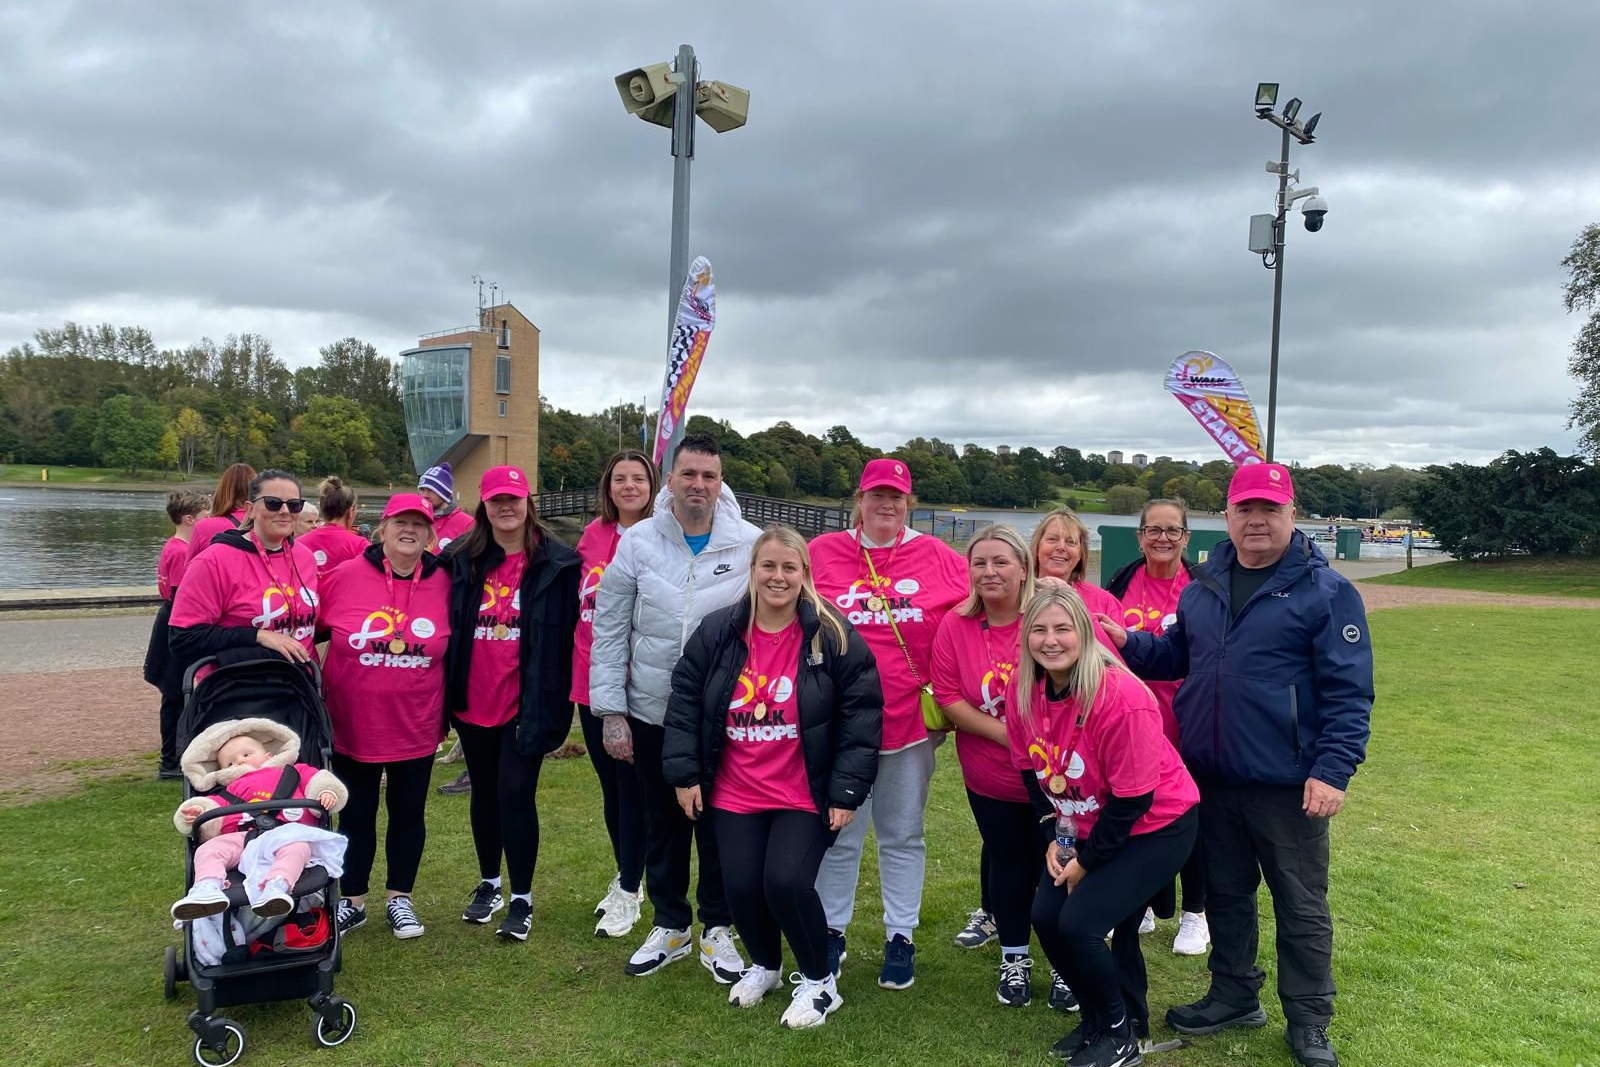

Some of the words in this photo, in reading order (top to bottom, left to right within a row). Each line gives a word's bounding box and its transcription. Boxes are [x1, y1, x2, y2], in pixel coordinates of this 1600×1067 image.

[1189, 400, 1250, 458] START
[848, 611, 873, 624] OF
[874, 608, 923, 624] HOPE
[370, 641, 427, 656] WLK
[359, 652, 384, 667] OF
[384, 653, 432, 669] HOPE
[726, 726, 746, 742] OF
[747, 724, 798, 742] HOPE
